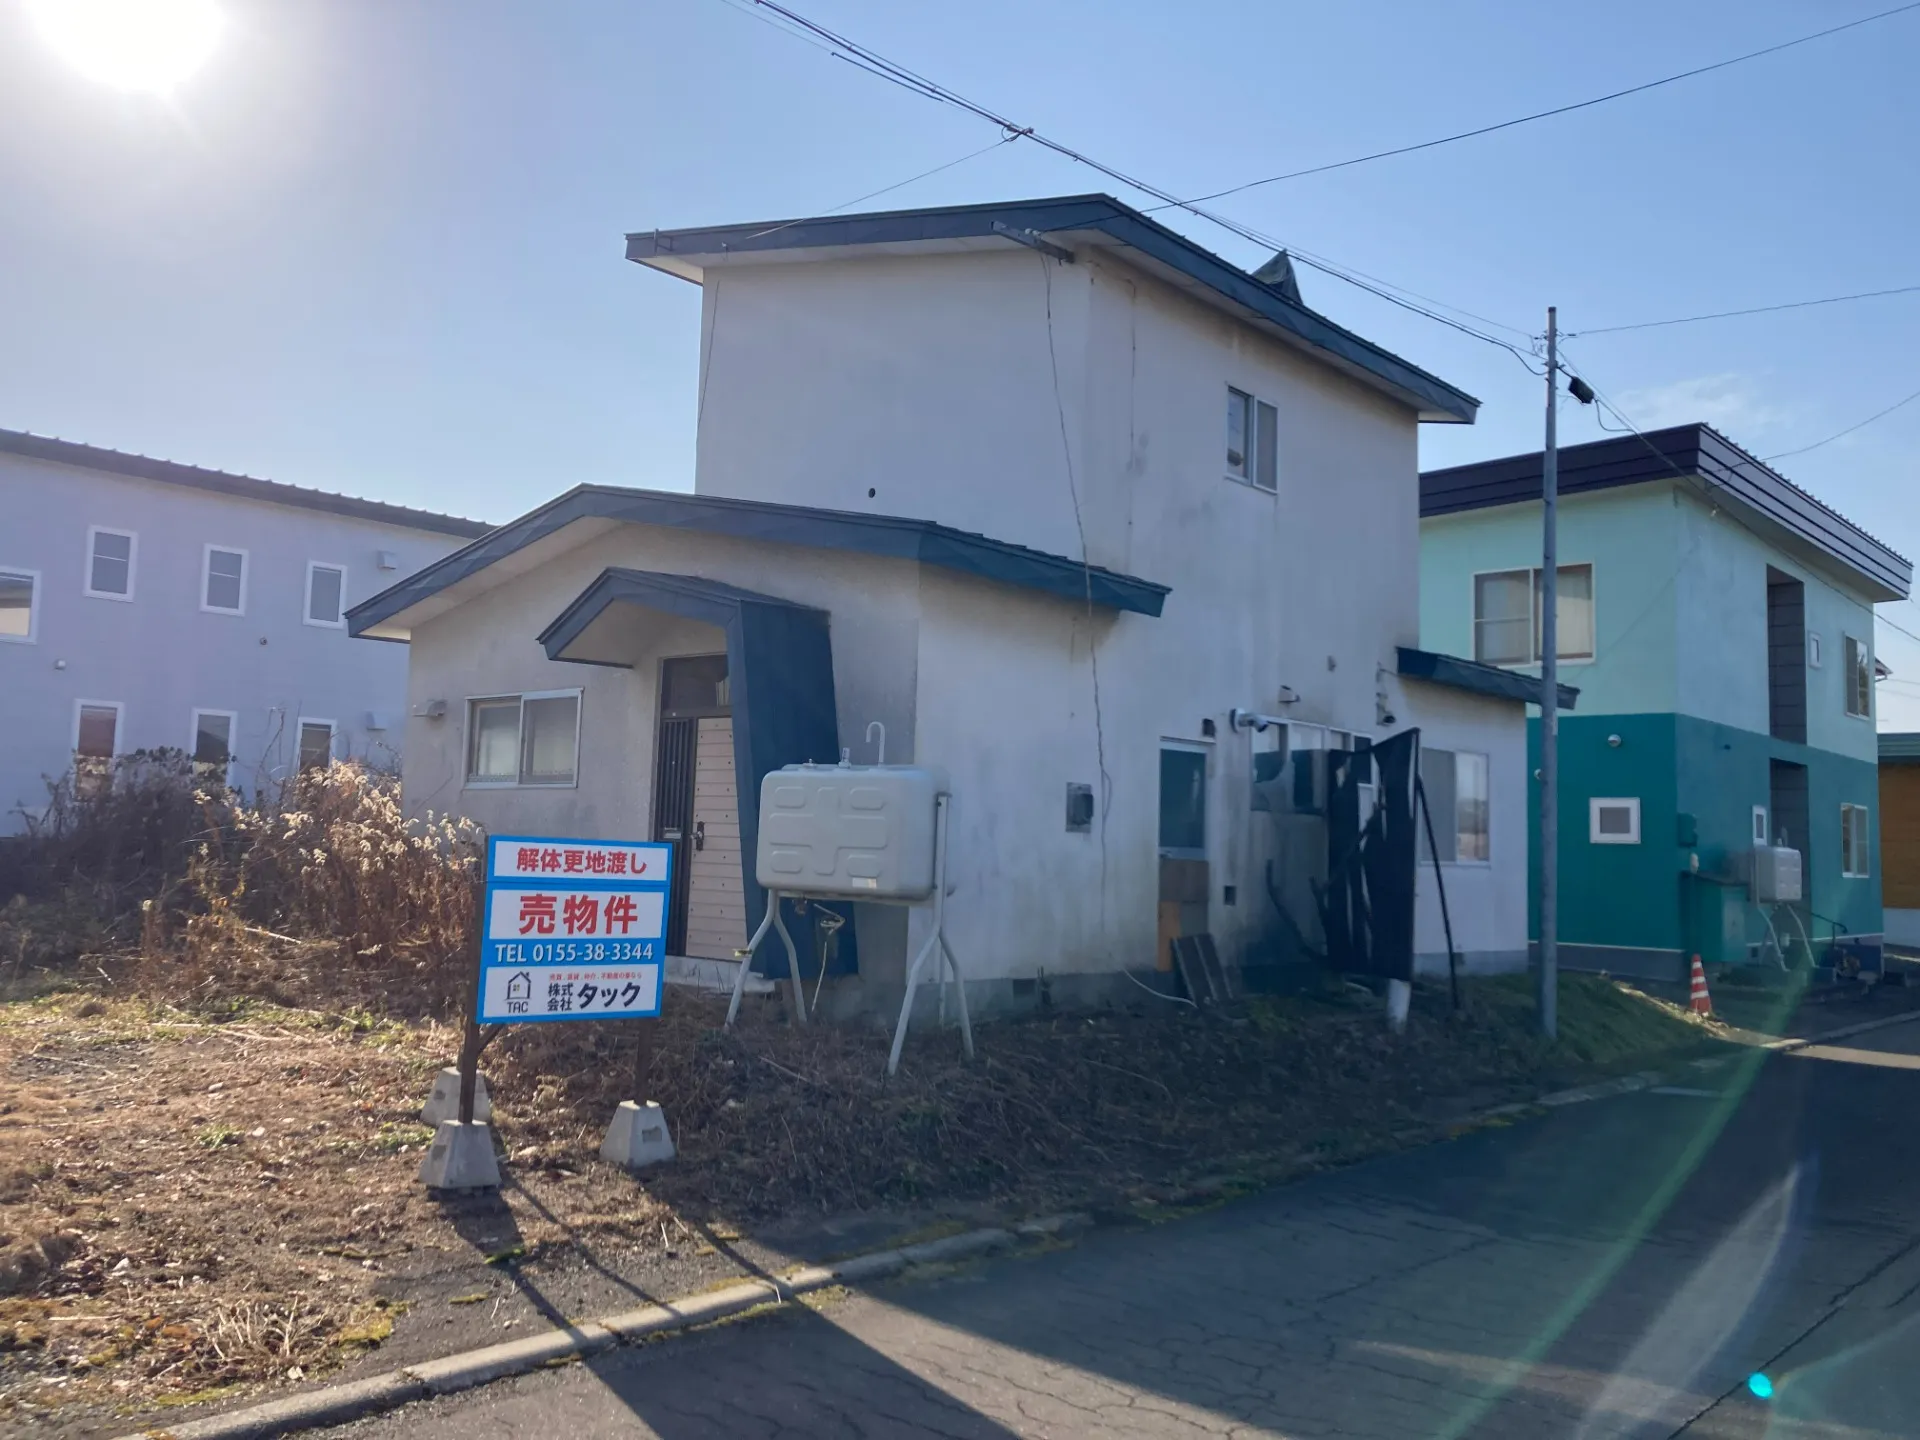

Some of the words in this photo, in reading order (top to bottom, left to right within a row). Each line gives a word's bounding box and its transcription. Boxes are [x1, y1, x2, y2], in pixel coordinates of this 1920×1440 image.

[516, 847, 647, 875] 解体更地渡し
[518, 893, 639, 935] 売物件
[495, 944, 527, 963] TEL
[532, 943, 653, 962] 0155-38-3344
[507, 1001, 529, 1014] TAC
[577, 981, 641, 1010] タック
